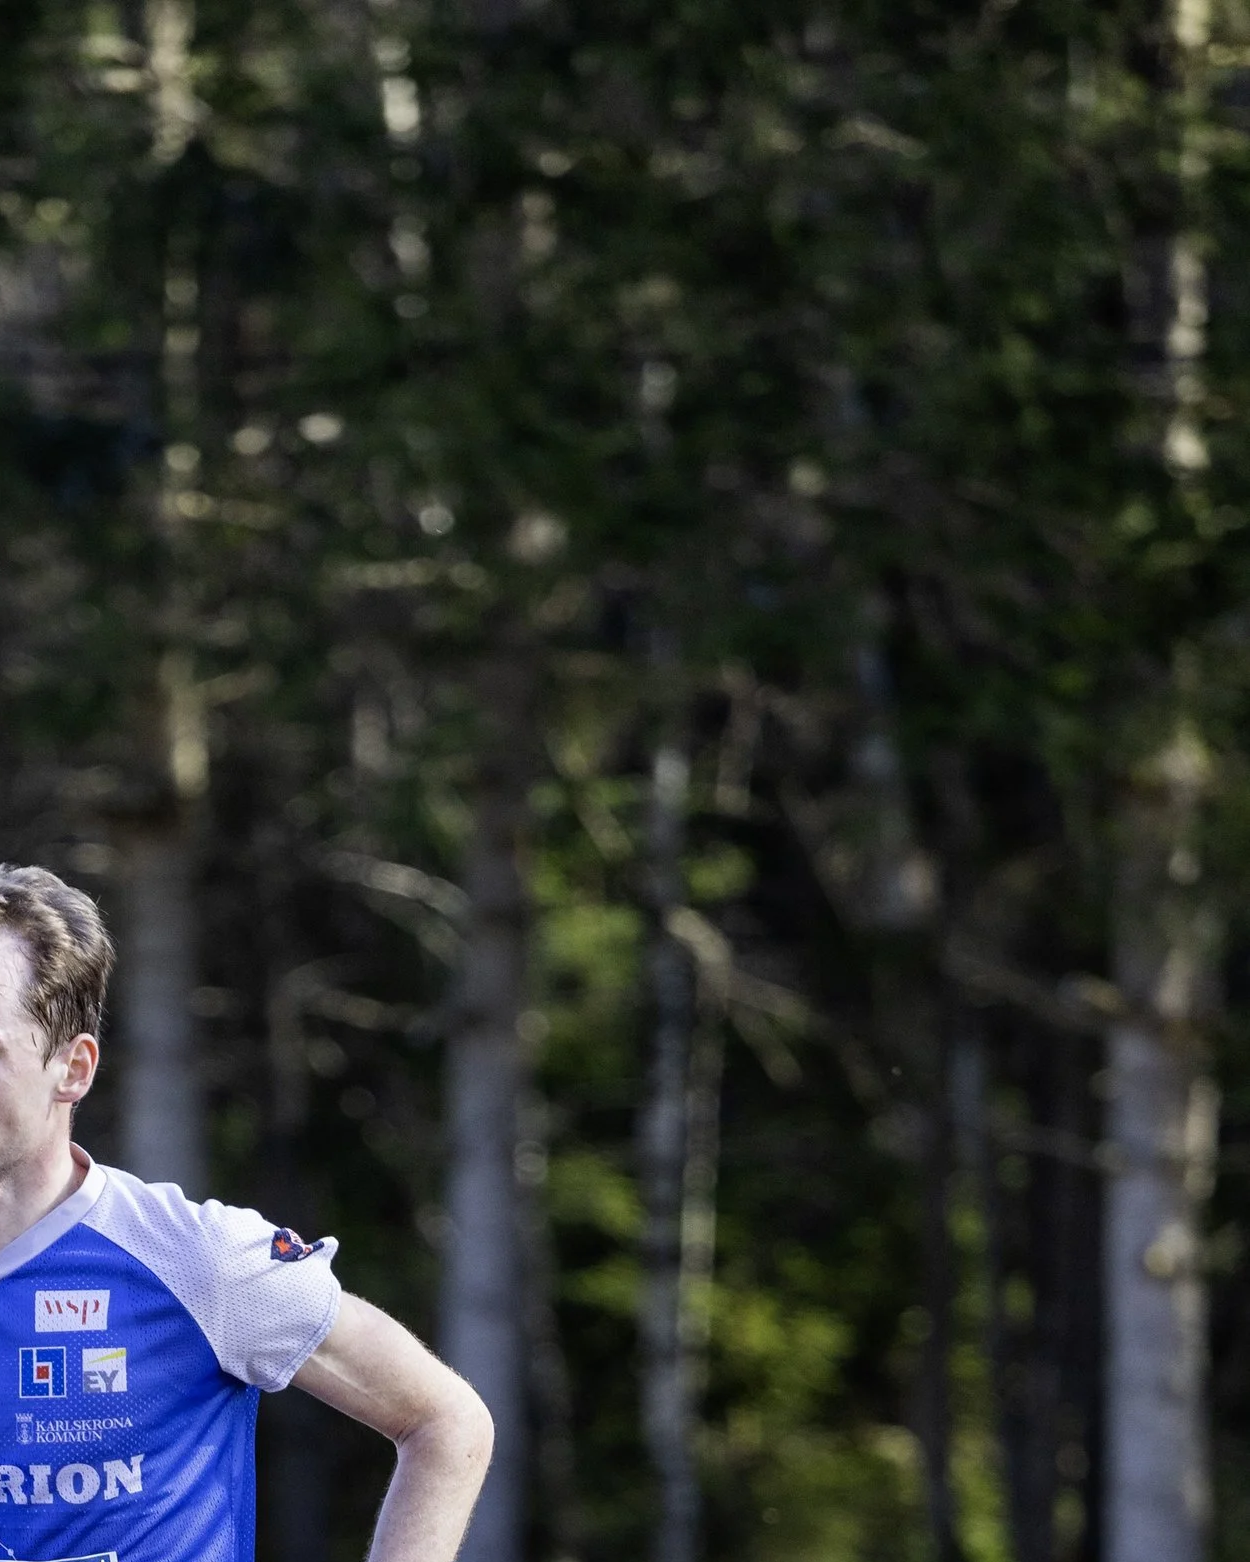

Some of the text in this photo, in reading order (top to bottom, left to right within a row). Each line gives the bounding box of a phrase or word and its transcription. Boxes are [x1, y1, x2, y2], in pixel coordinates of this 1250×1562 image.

[83, 1370, 119, 1392] EY
[35, 1417, 134, 1432] KARLSKRONA
[35, 1430, 103, 1443] KOMMUN
